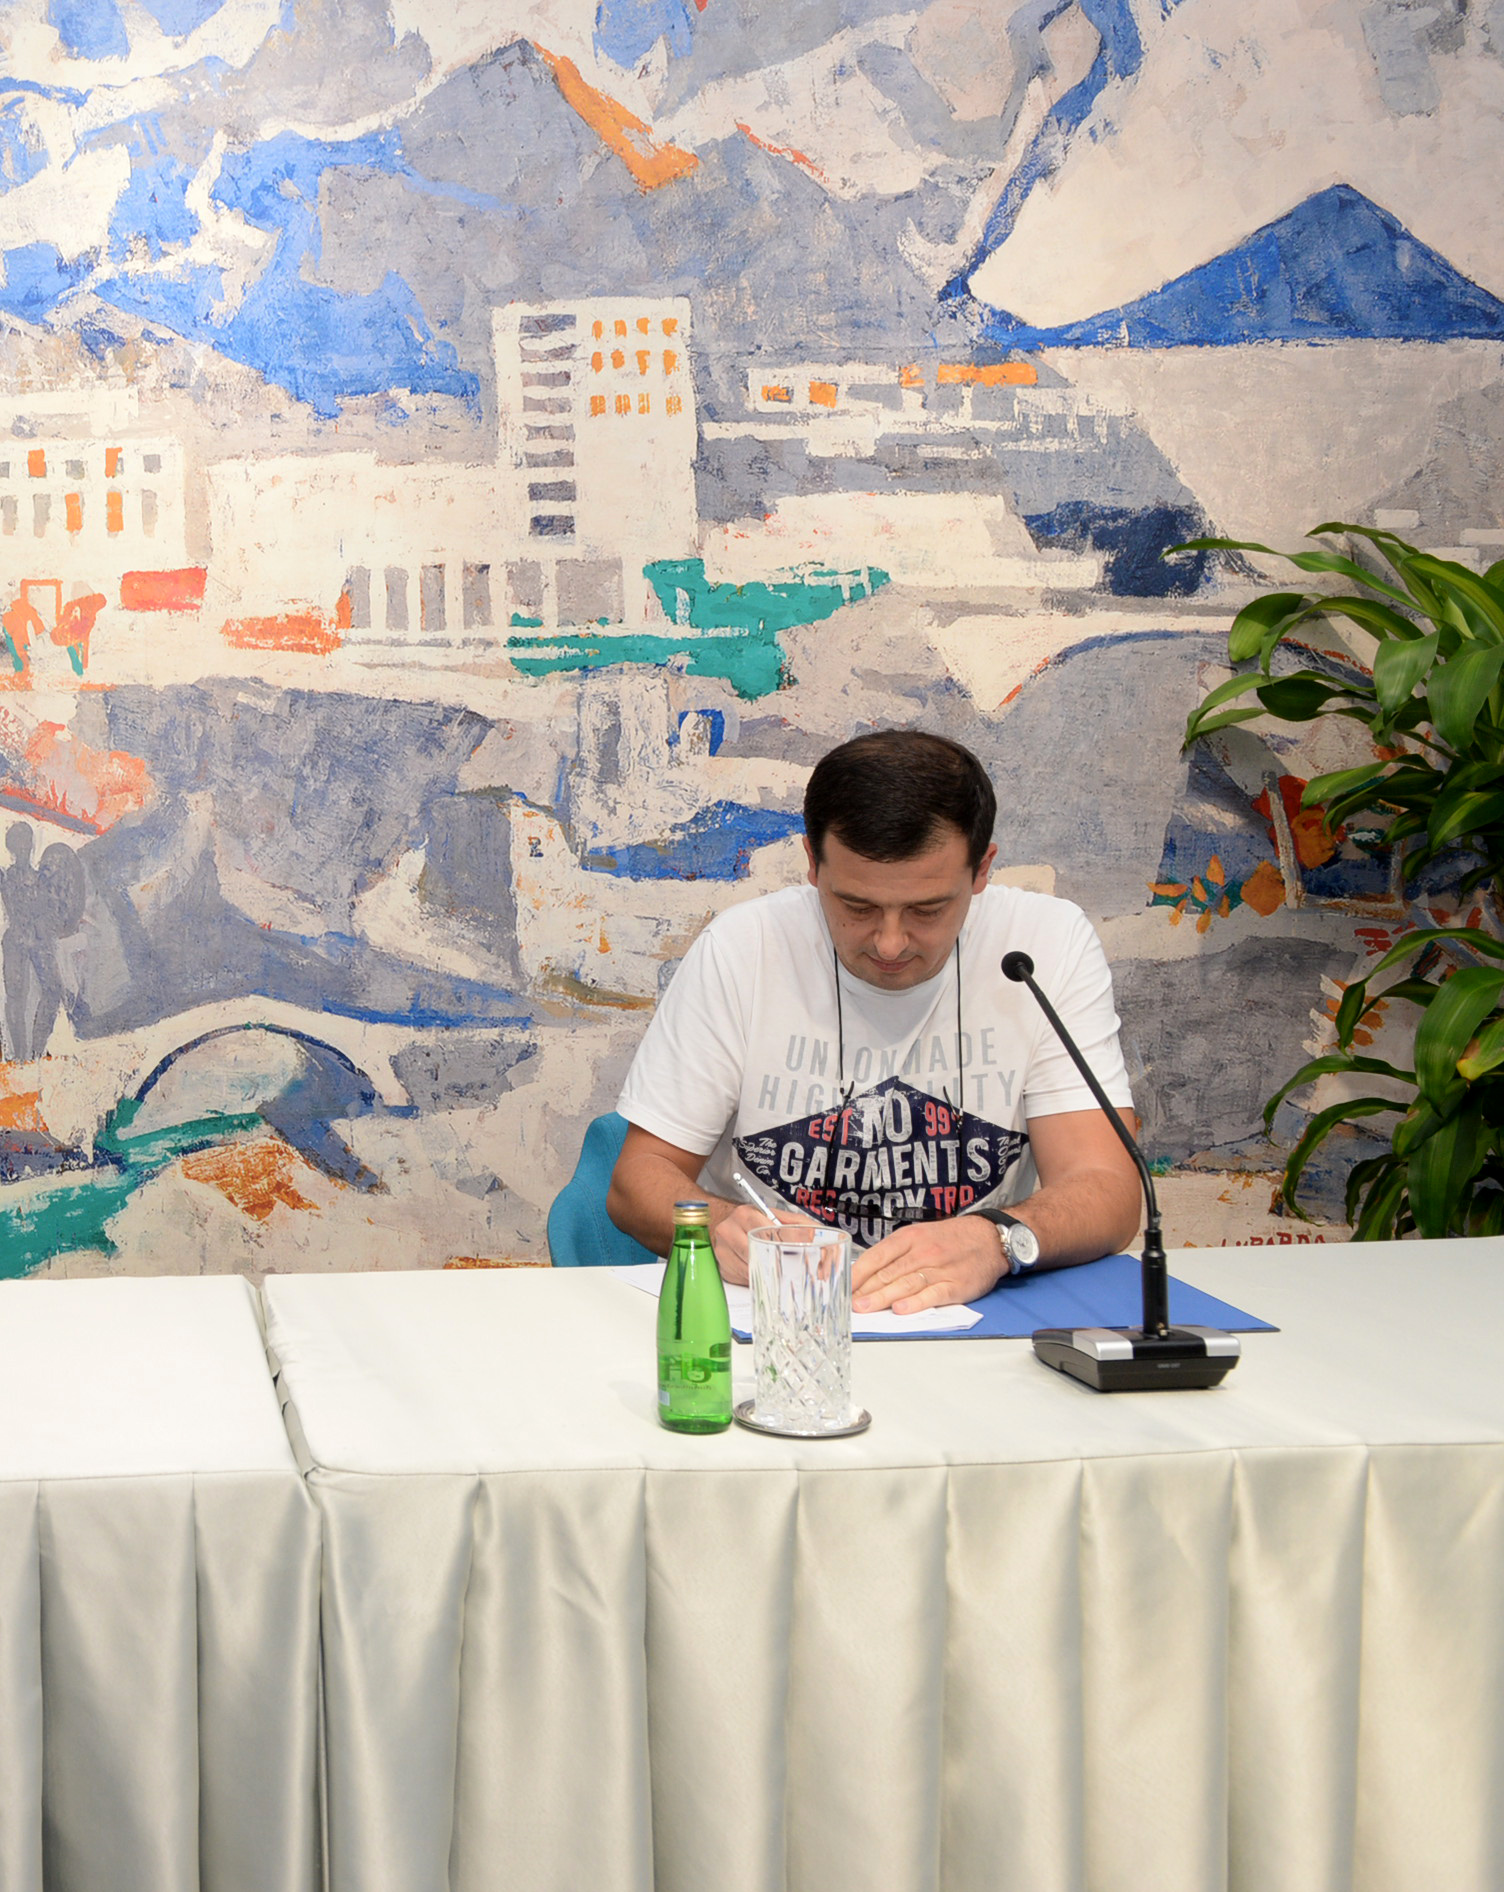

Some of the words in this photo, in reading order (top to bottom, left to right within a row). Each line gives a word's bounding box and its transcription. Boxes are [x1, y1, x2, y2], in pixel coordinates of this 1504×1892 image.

[808, 1107, 854, 1146] EST
[739, 1140, 776, 1157] Superior
[758, 1137, 777, 1149] The
[745, 1153, 775, 1167] Denim
[779, 1136, 991, 1192] GARMENTS
